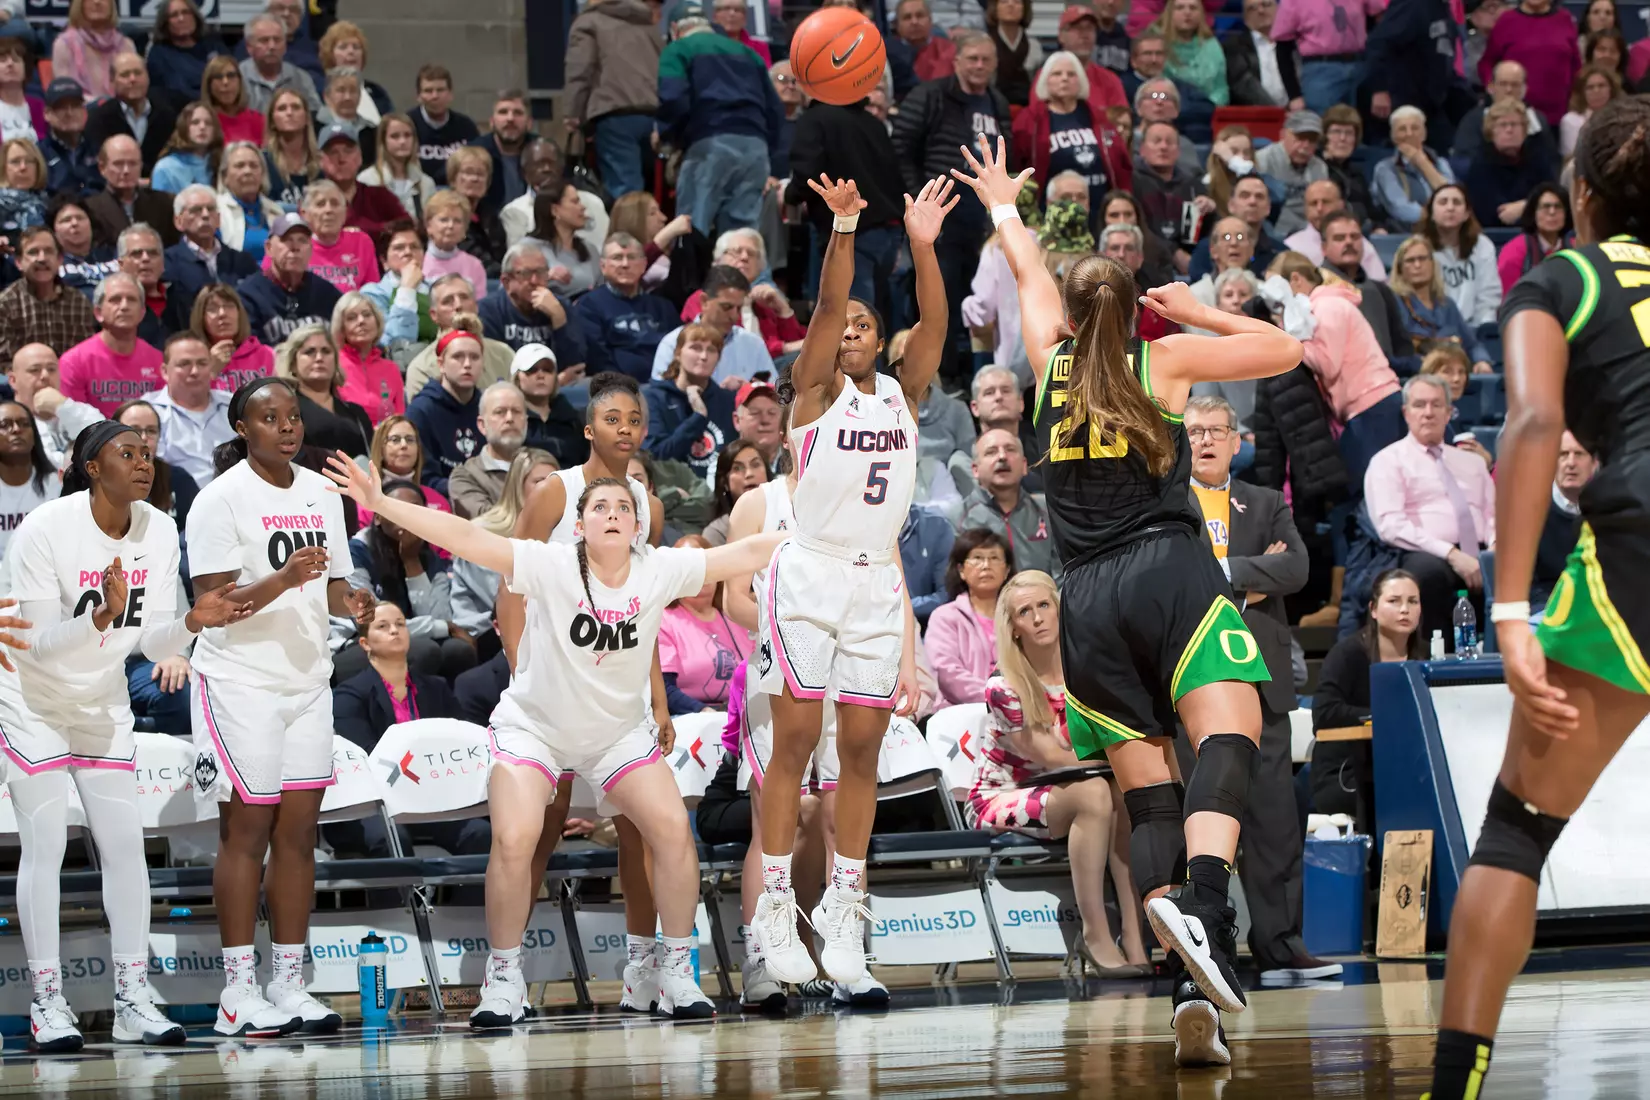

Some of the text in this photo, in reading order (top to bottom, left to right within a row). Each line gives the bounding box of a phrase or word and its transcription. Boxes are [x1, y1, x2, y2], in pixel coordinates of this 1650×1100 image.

[836, 428, 909, 452] UCONN
[863, 461, 891, 506] 5
[261, 514, 324, 531] POWER OF
[131, 569, 148, 586] OF
[569, 612, 639, 651] ONE
[871, 909, 977, 937] genius3D
